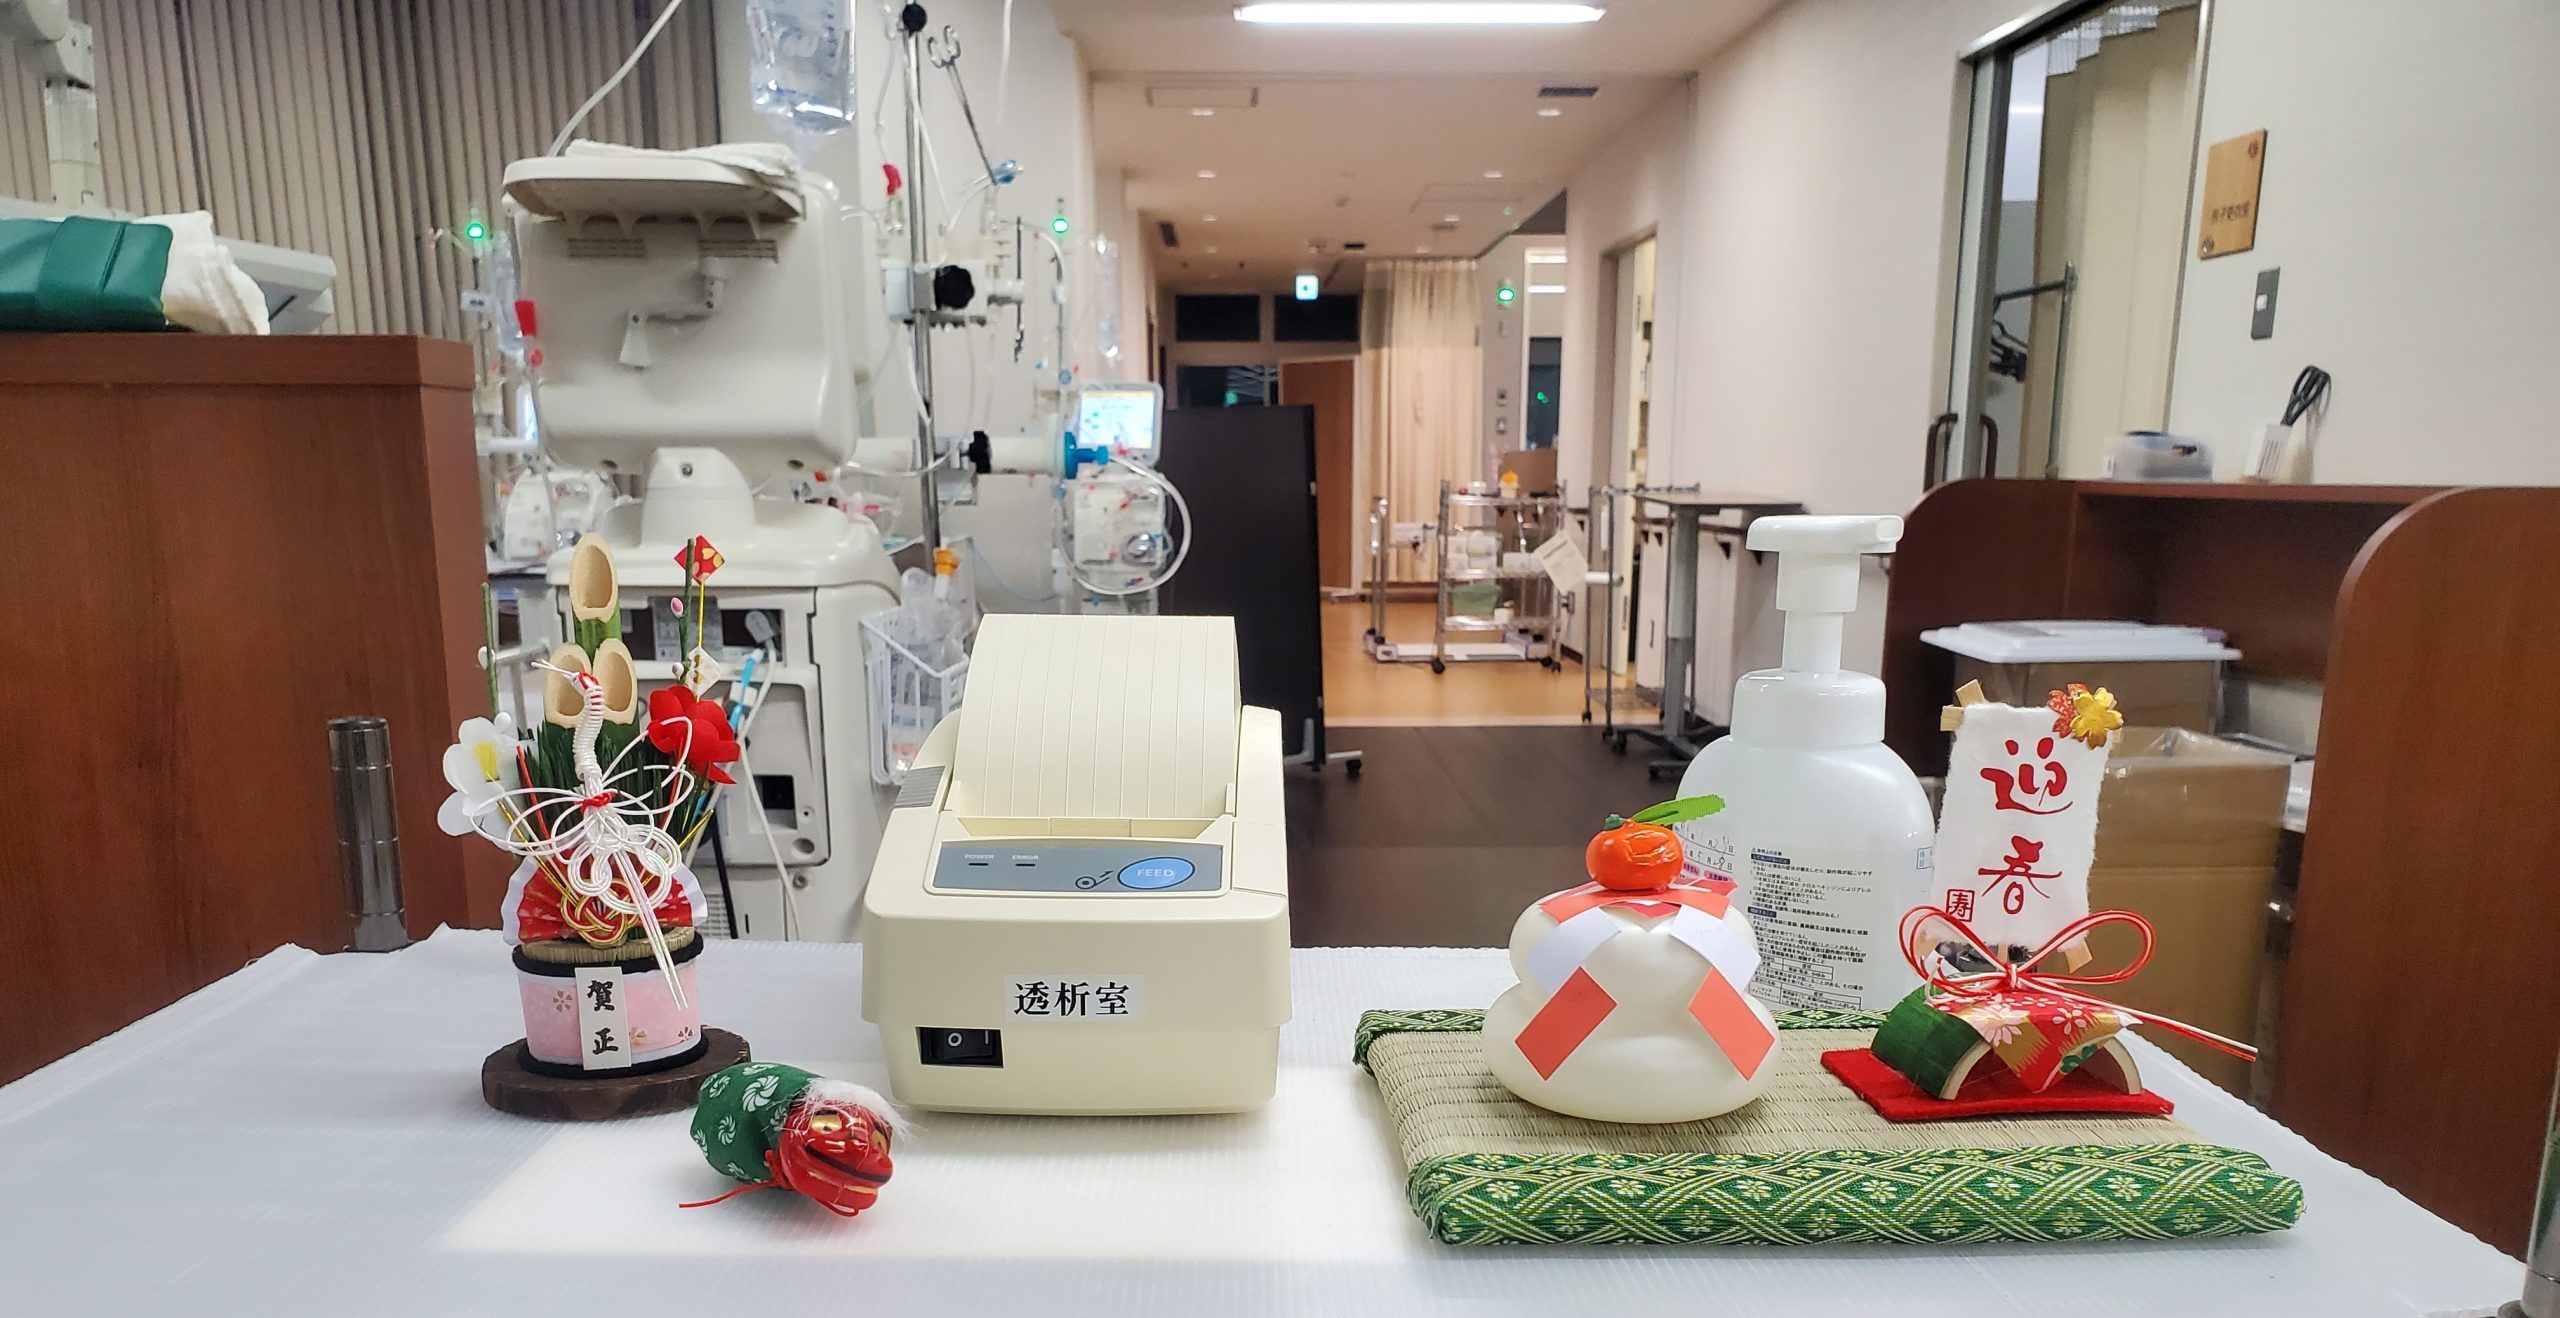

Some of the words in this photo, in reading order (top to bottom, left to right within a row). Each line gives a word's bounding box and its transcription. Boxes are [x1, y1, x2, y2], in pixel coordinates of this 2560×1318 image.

[1978, 737, 2073, 914] 迎春
[1137, 869, 1175, 877] FEED
[1949, 892, 1971, 918] 寿
[1013, 981, 1130, 1017] 透析室
[586, 980, 619, 1056] 賀正
